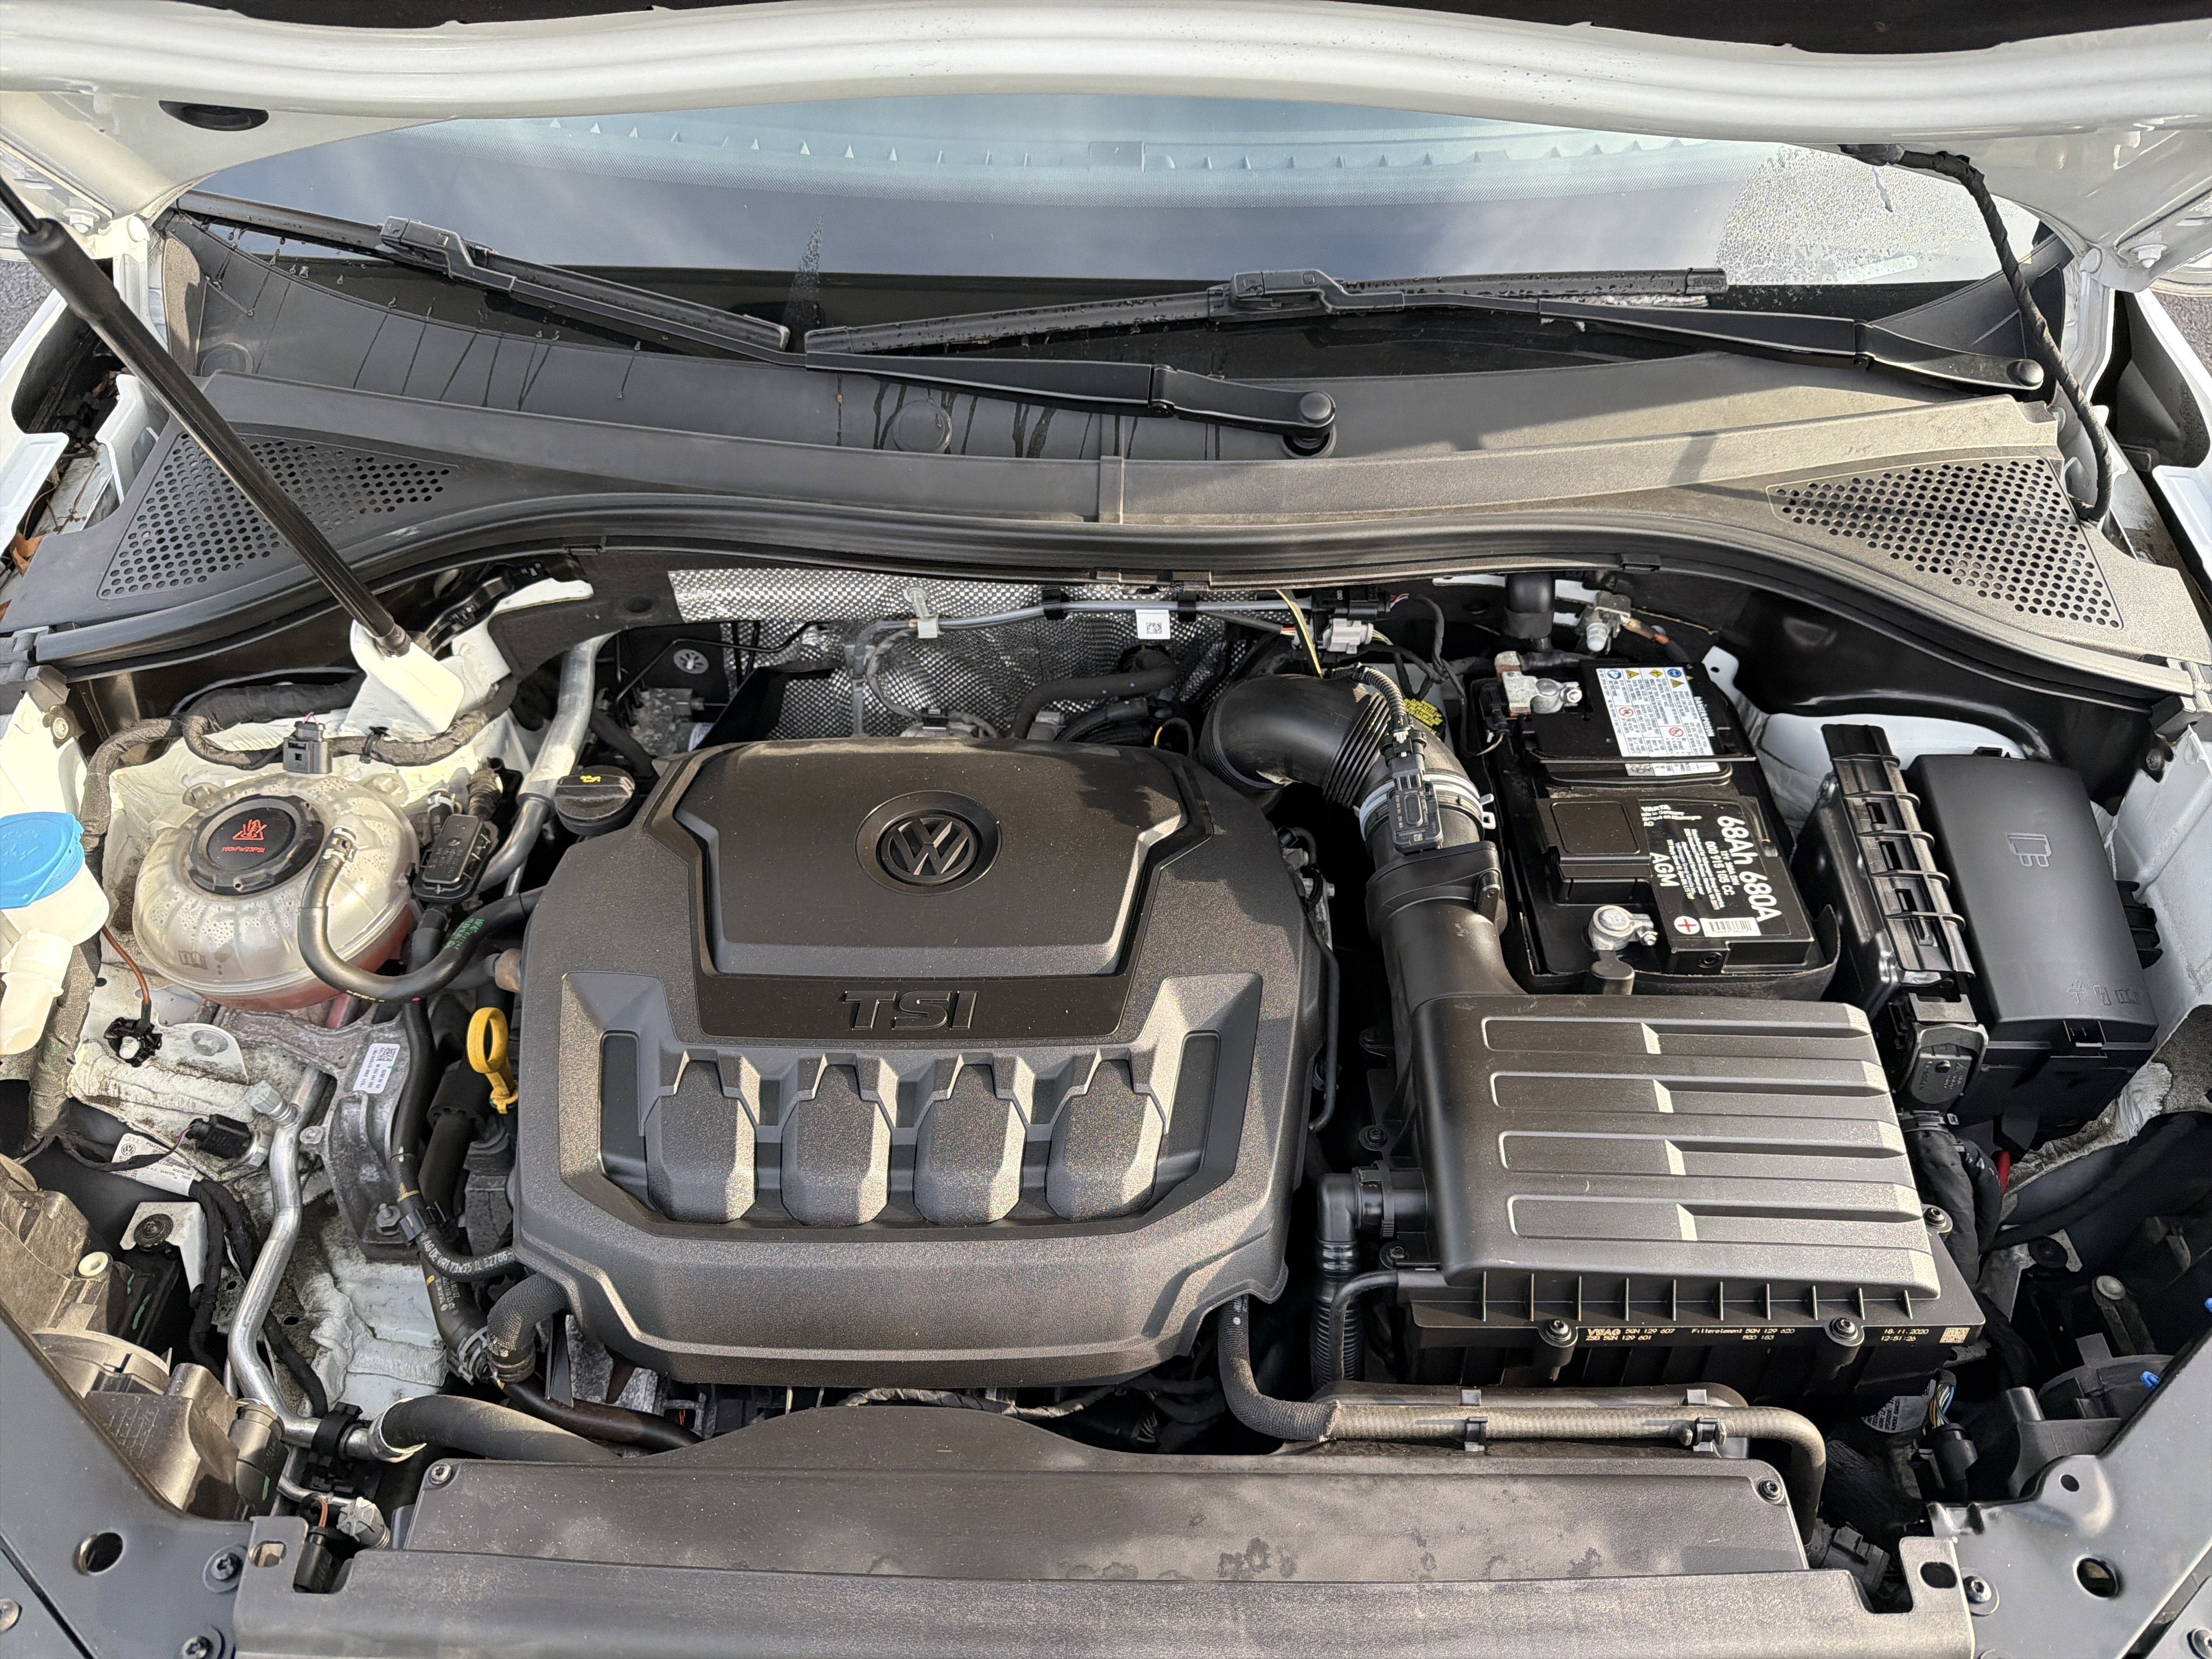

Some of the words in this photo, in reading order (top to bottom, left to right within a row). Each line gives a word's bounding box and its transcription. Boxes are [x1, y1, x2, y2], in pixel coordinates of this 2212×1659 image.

[1704, 841, 1719, 854] 000
[1709, 855, 1725, 868] 915
[1649, 852, 1680, 887] AGM
[1717, 816, 1758, 865] 68Ah
[1739, 871, 1782, 922] 680A
[1715, 870, 1730, 883] 105
[1720, 885, 1735, 895] CC
[842, 990, 978, 1030] TSI
